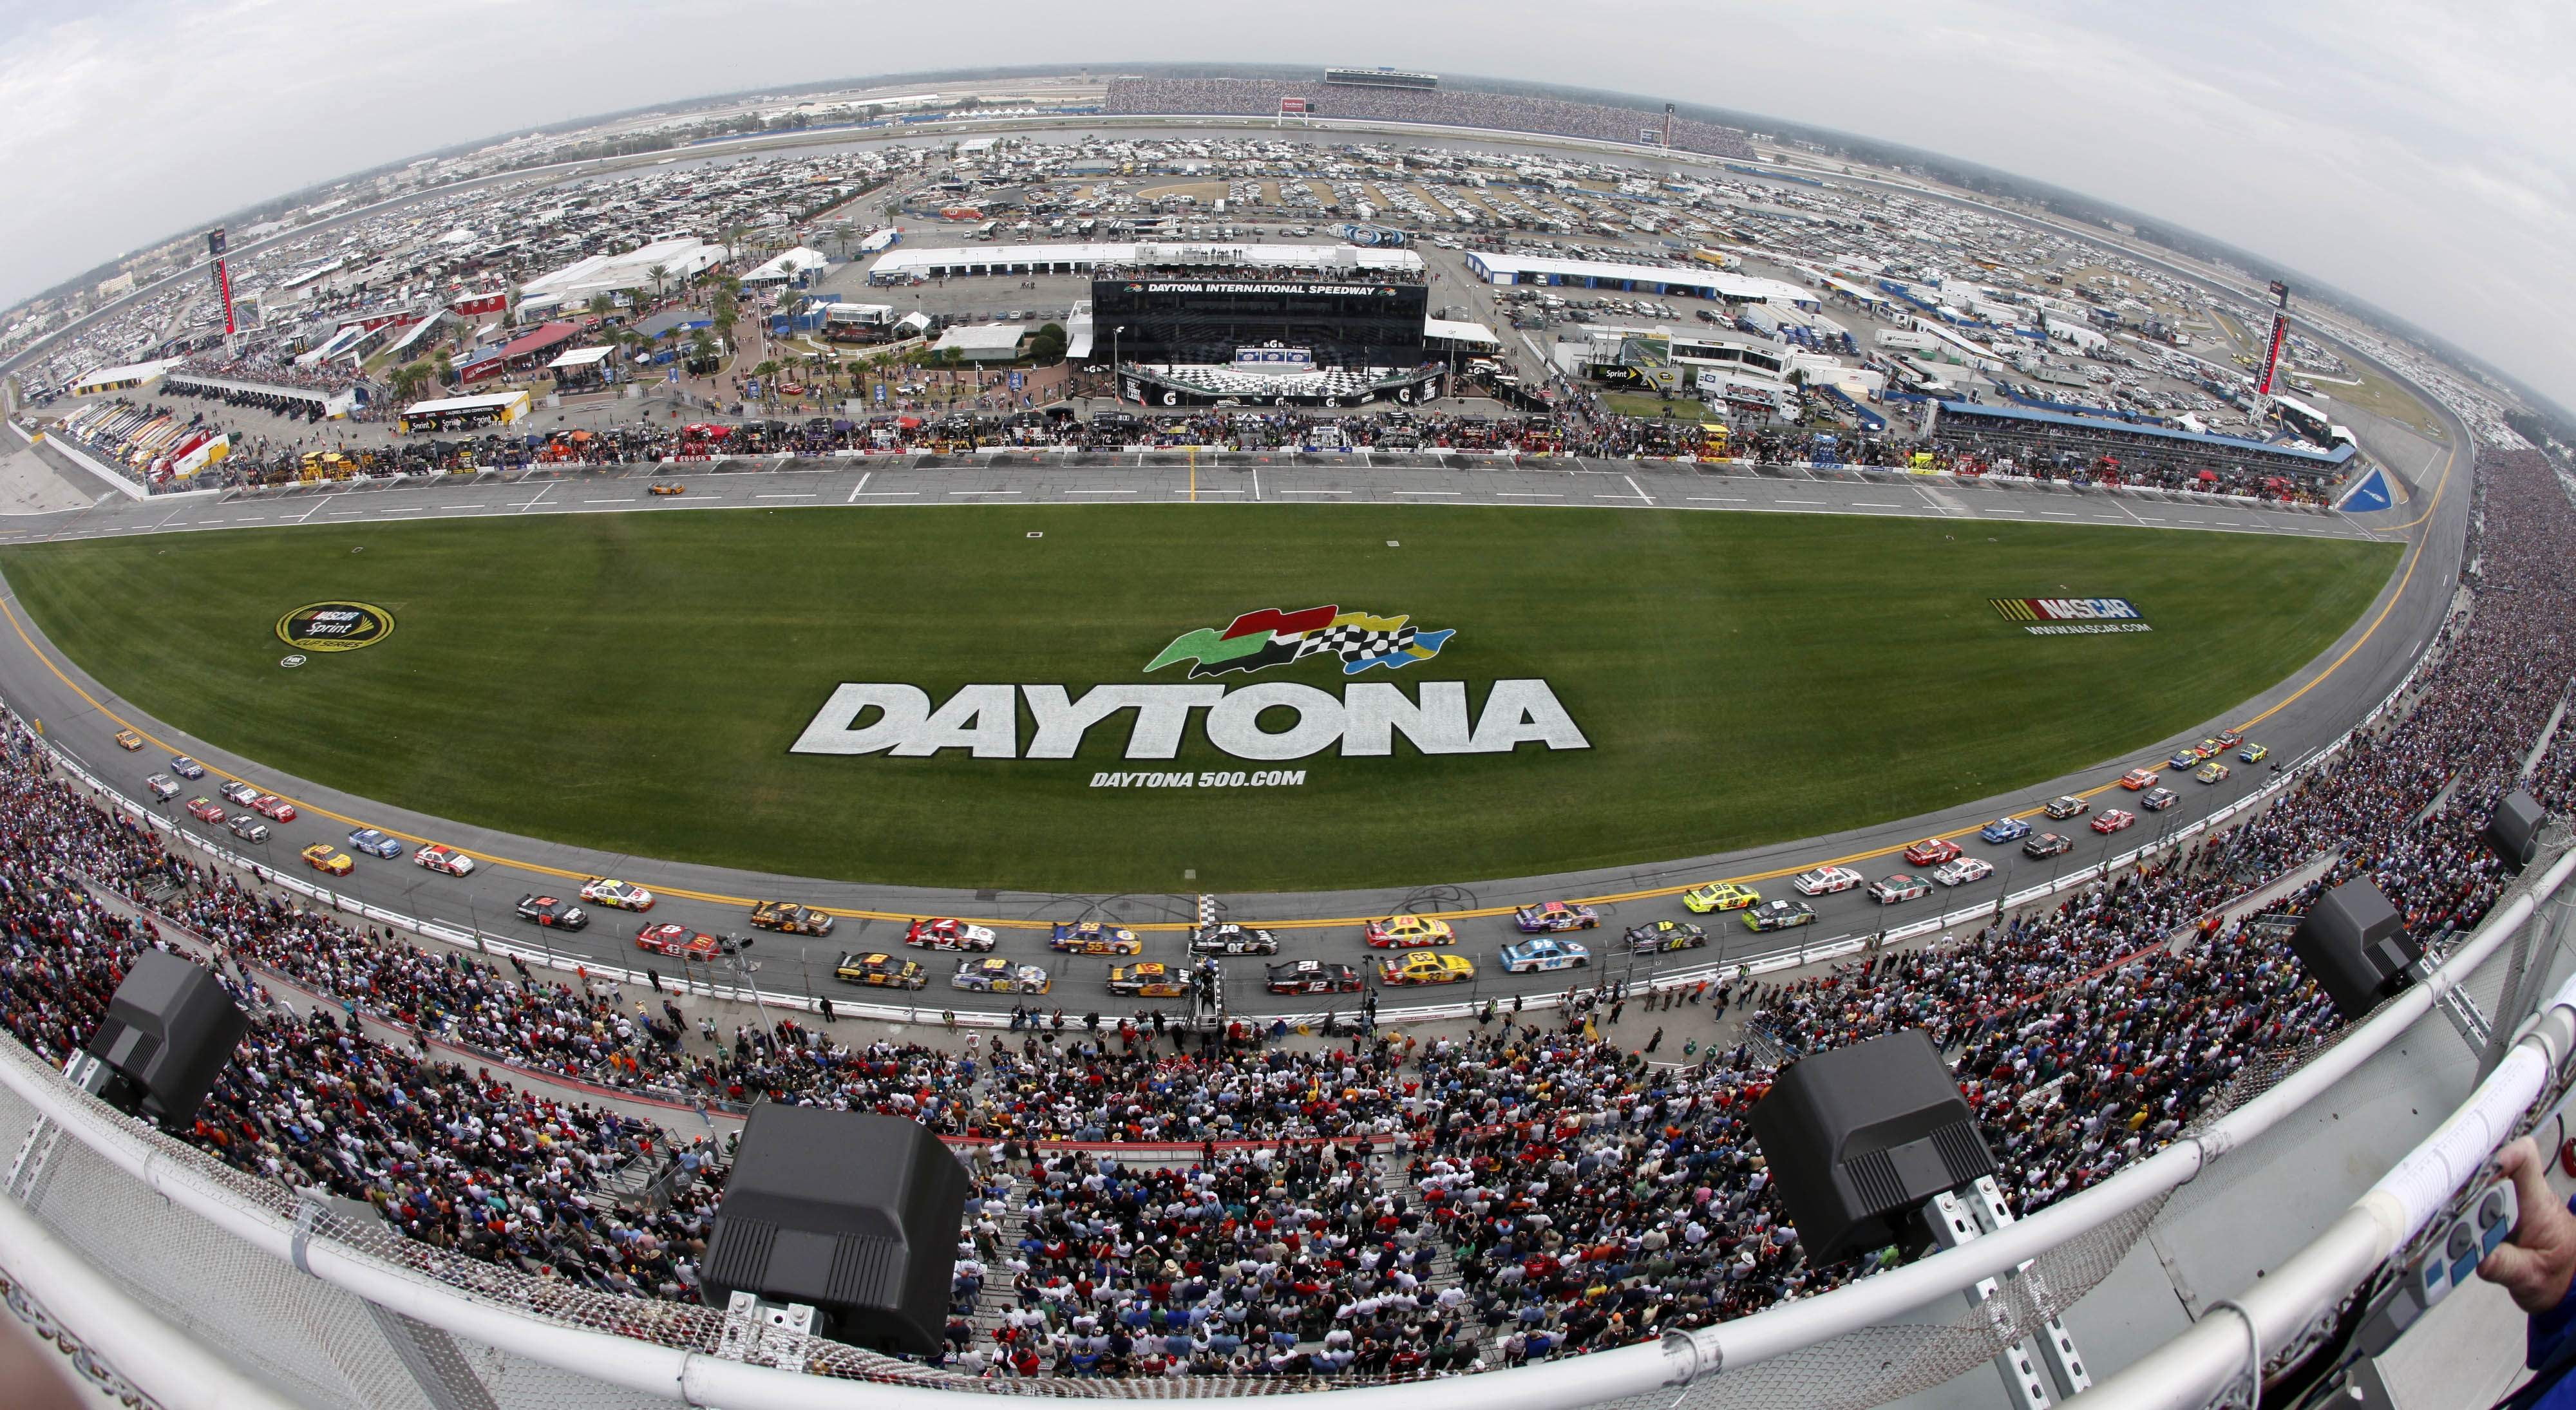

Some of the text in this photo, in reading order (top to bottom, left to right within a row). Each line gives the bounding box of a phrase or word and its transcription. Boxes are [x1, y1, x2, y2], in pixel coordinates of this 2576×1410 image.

[1148, 284, 1375, 296] DAYTONA INTERNATIONAL SPEEDWAY
[1606, 370, 1627, 378] Sprint
[1164, 391, 1176, 406] G
[1399, 388, 1409, 402] G
[1423, 392, 1435, 400] LANE
[1326, 398, 1335, 407] G
[473, 415, 491, 424] Sprint
[2038, 599, 2137, 619] NASCAR
[312, 611, 359, 621] NASCAR
[306, 622, 352, 635] Sprint
[2025, 623, 2153, 635] WWW.NASCAR.COM
[790, 679, 1592, 760] DAYTONA
[1089, 770, 1306, 788] DAYTONA 500.COM
[1938, 851, 1948, 861] 9
[631, 888, 645, 900] 3M
[606, 897, 618, 905] 16
[1078, 923, 1101, 931] 55
[1217, 925, 1240, 934] 07
[944, 938, 956, 948] 7
[1408, 935, 1422, 945] 47
[666, 944, 680, 954] 43
[1086, 941, 1104, 951] 55
[1227, 943, 1245, 953] 07
[1297, 960, 1319, 971] 12
[1425, 972, 1441, 982] 33
[1309, 981, 1328, 992] 12
